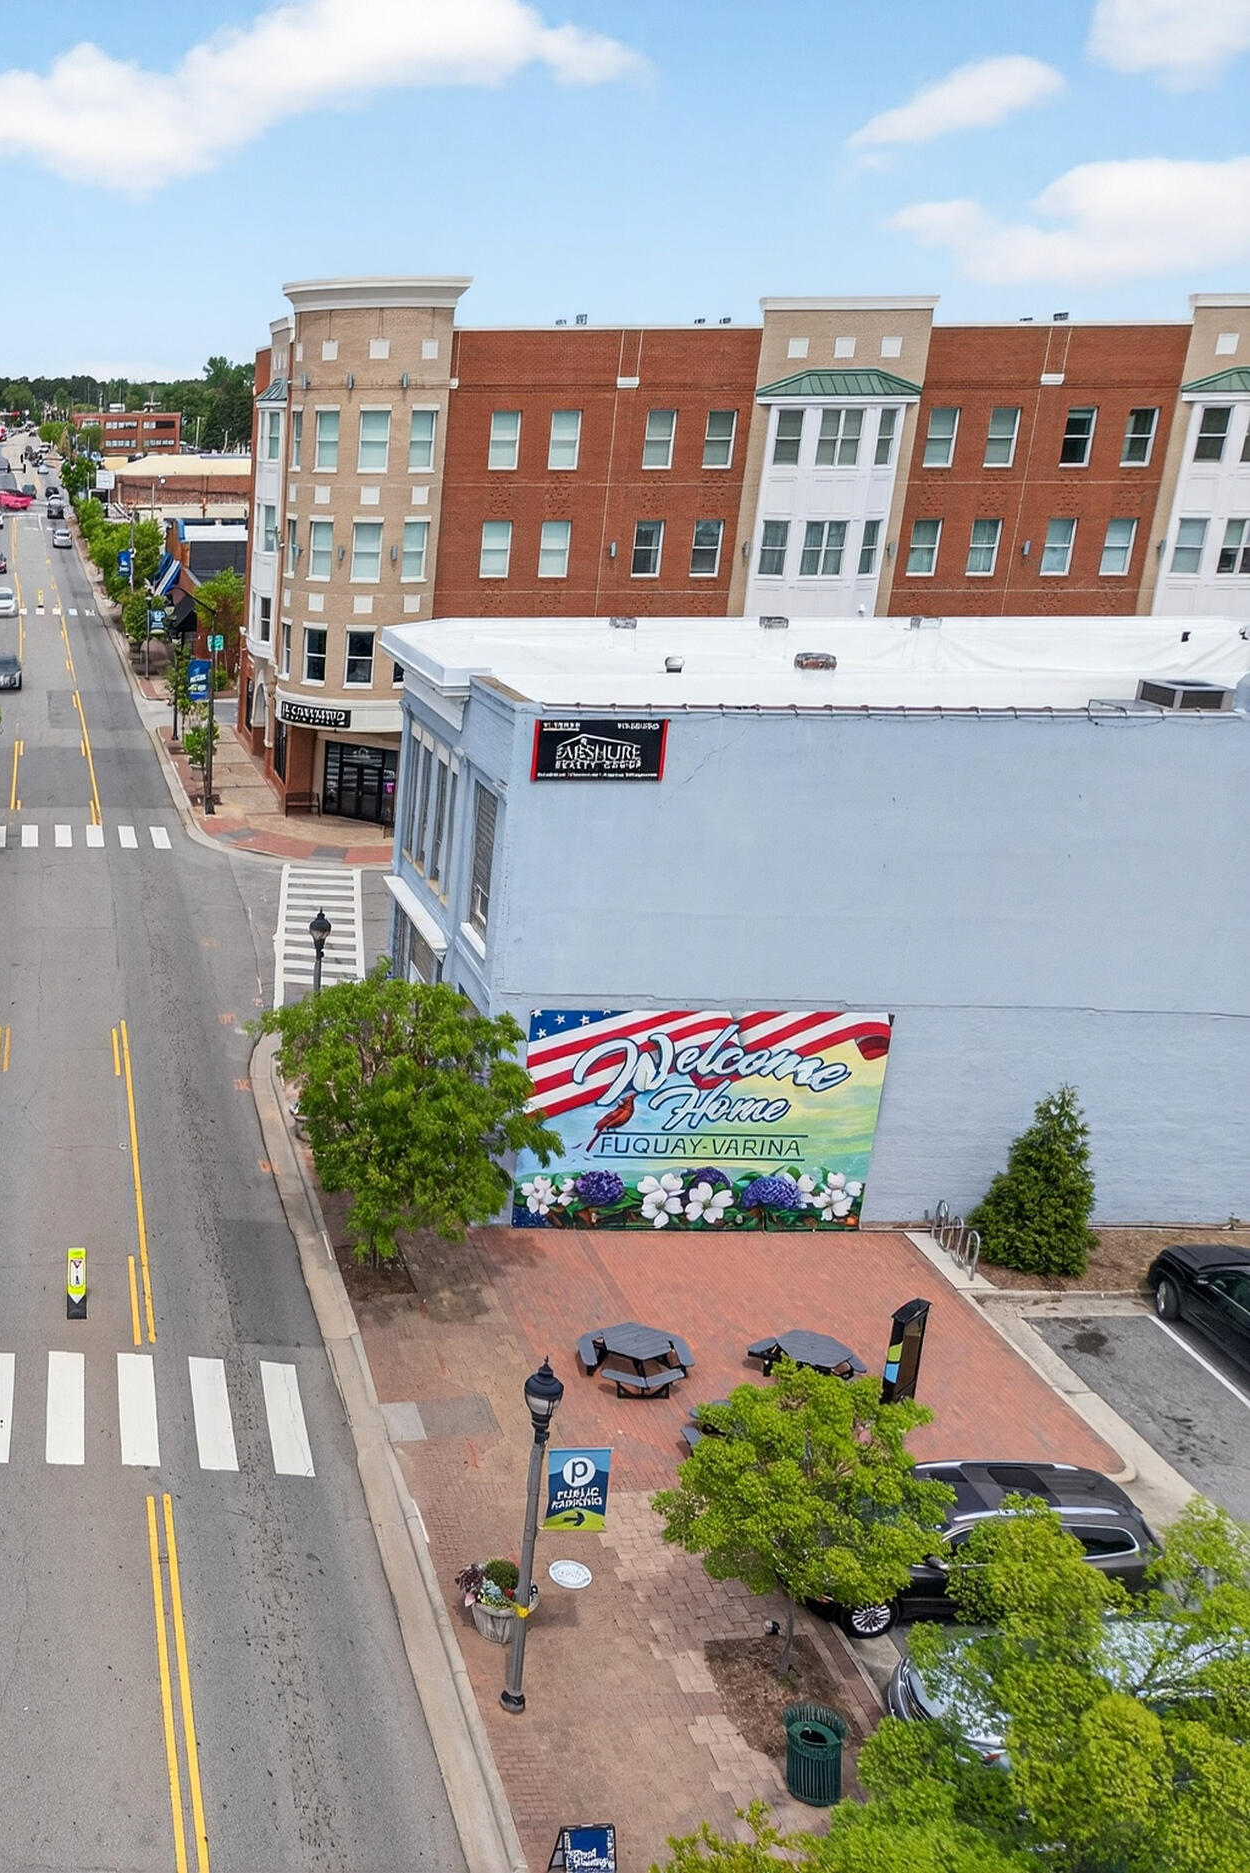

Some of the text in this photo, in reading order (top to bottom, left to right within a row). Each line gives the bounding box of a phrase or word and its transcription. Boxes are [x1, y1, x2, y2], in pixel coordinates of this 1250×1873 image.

[573, 1023, 853, 1108] Welcome
[648, 1079, 792, 1132] Home
[600, 1135, 801, 1157] FUQUAY-VARINA
